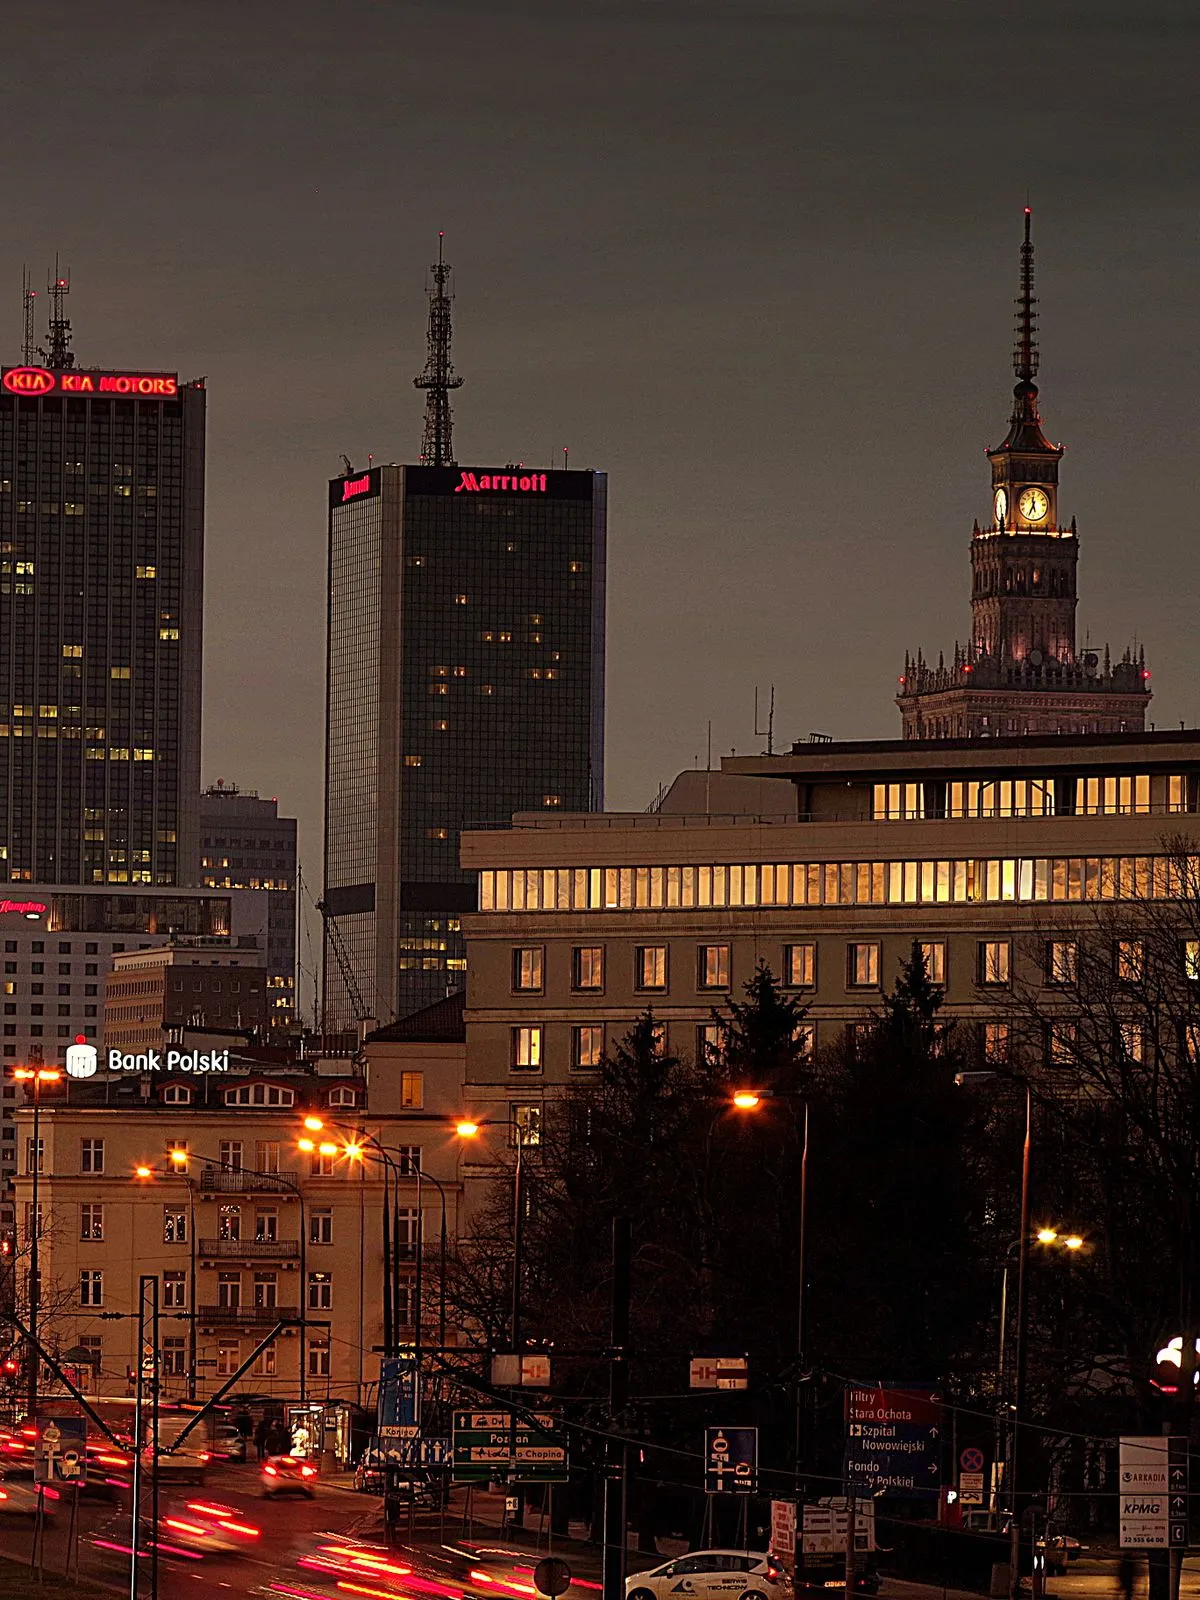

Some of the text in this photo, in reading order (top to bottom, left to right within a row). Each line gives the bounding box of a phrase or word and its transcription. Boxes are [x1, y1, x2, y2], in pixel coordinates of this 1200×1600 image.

[12, 373, 46, 390] KIA
[61, 375, 177, 395] KIA MOTORS
[454, 471, 548, 492] Marriott
[109, 1049, 229, 1072] Bank Polski
[849, 1407, 912, 1420] Stara Ochota
[490, 1433, 529, 1444] Pozań
[862, 1425, 896, 1439] Szpital
[862, 1439, 925, 1454] Nowowiejski
[526, 1449, 561, 1459] Chopina
[1133, 1473, 1166, 1482] ARKADIA
[1124, 1504, 1160, 1514] KPMG
